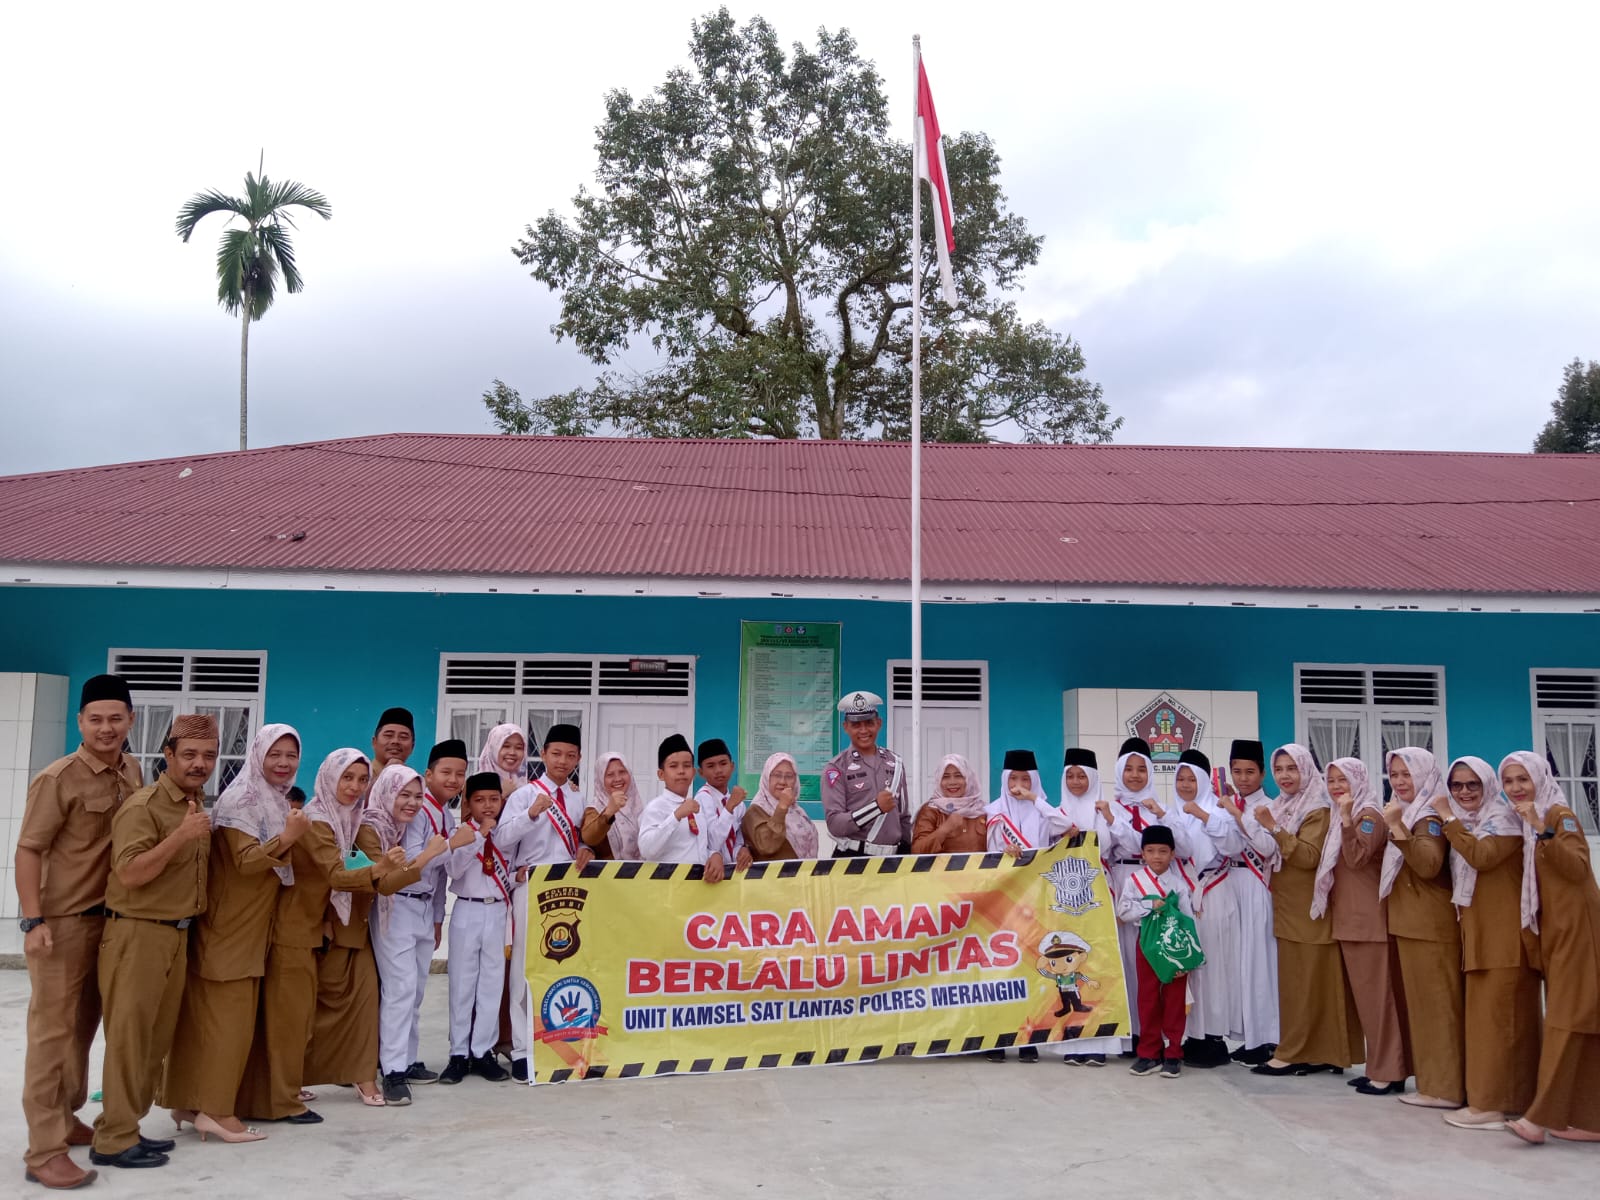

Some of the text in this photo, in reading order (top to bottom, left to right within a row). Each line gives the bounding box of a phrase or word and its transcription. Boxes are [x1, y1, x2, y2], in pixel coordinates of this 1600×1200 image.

[686, 904, 972, 949] CARA AMAN
[629, 934, 1018, 994] BERLALU LINTAS
[626, 980, 1025, 1029] UNIT KAMSEL SAT LANTAS POLRES MERANGIN
